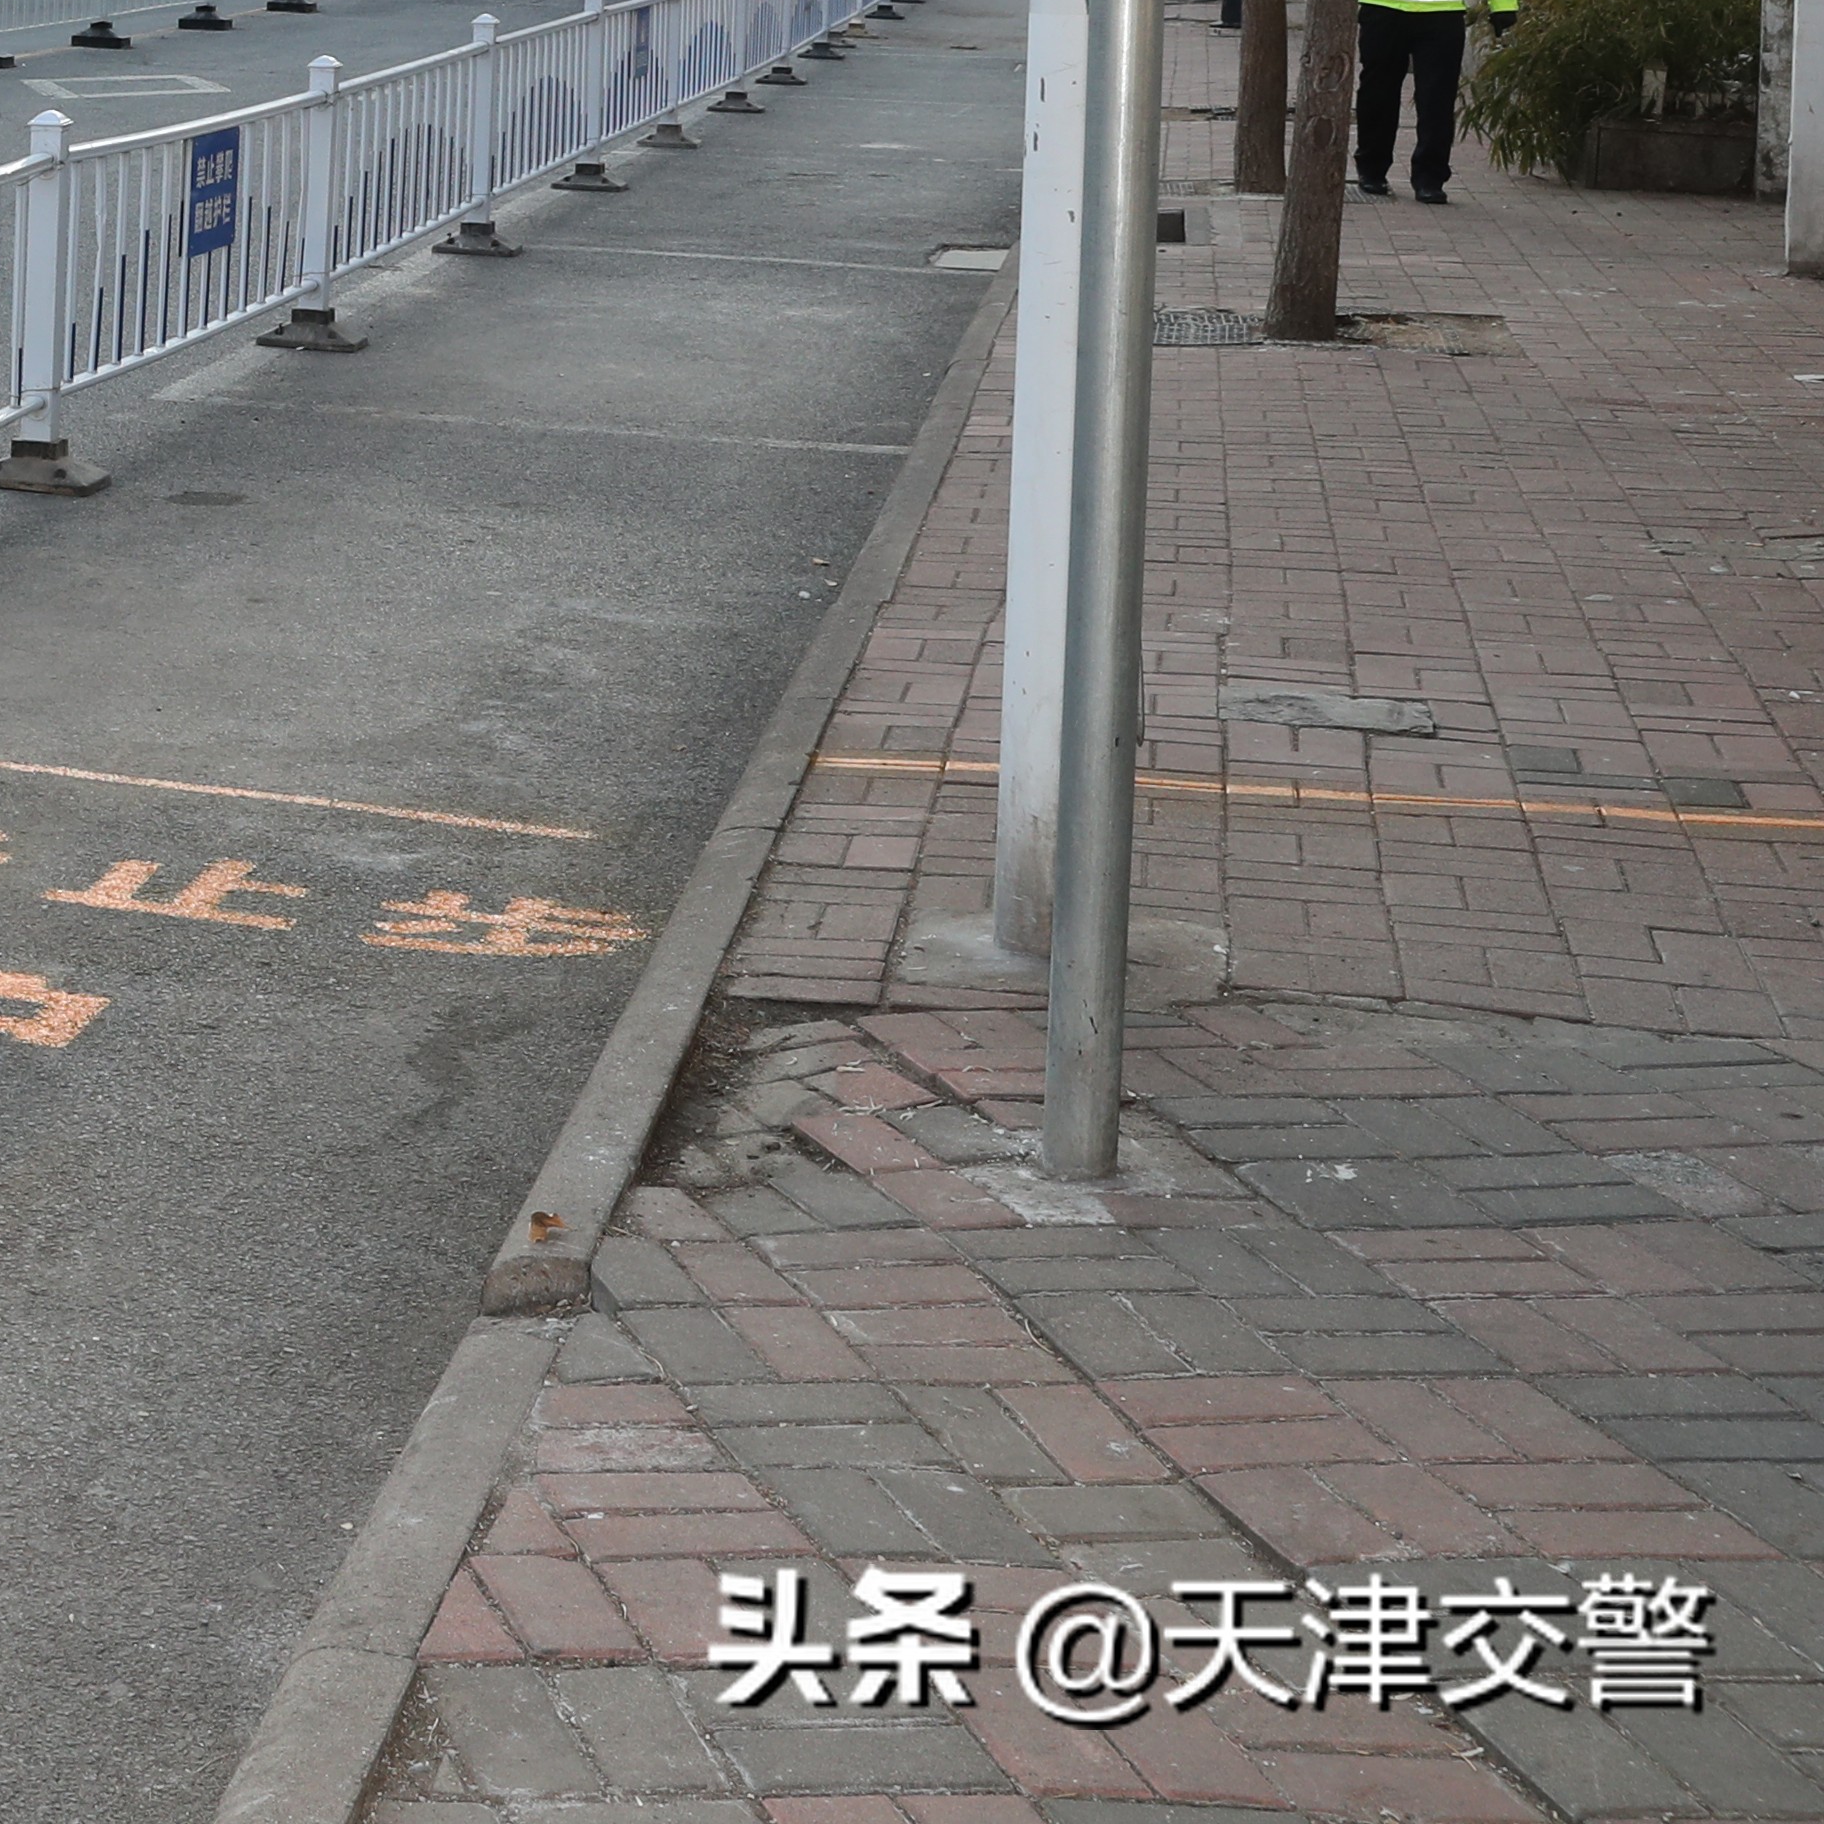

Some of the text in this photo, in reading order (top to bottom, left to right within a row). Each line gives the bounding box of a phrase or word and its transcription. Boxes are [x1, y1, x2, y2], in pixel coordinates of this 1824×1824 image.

[195, 149, 234, 189] 禁止攀爬
[194, 192, 232, 234] 翻越护栏
